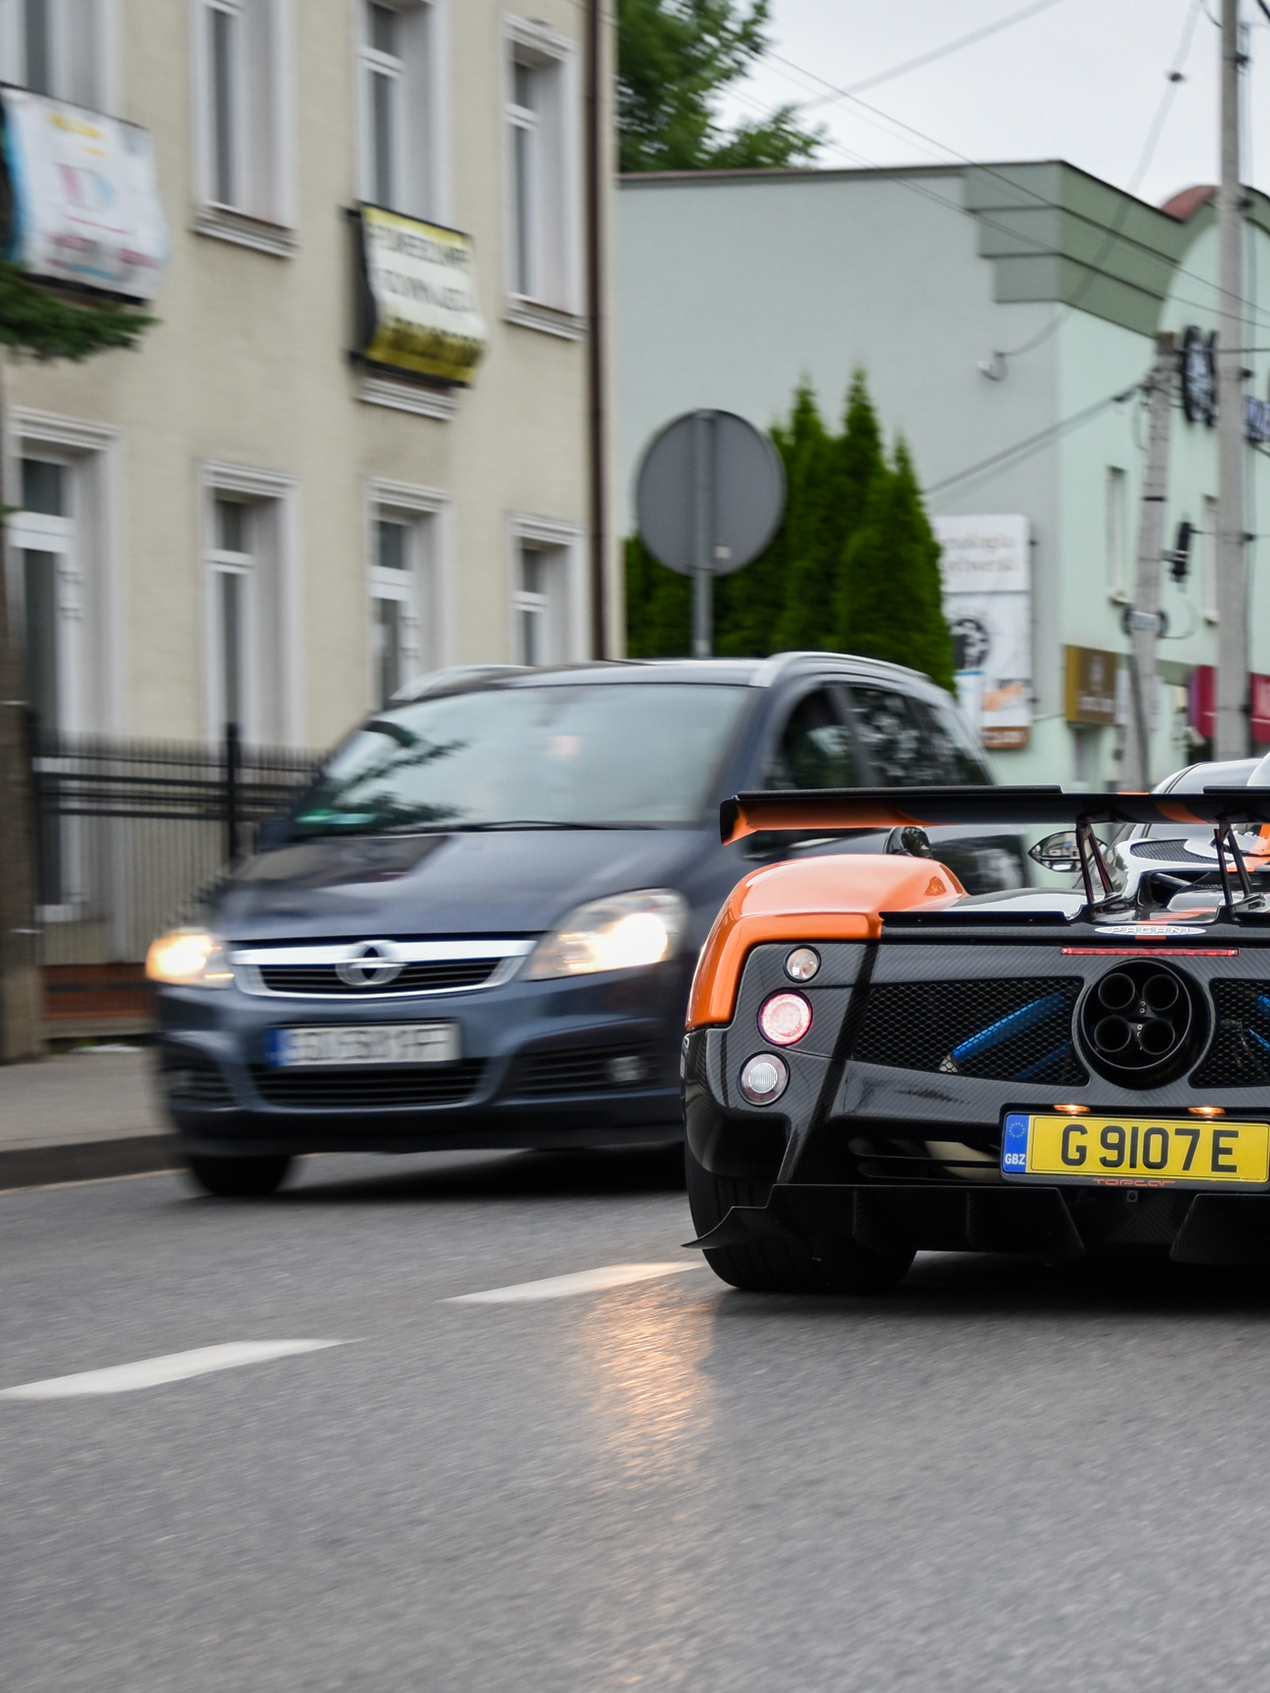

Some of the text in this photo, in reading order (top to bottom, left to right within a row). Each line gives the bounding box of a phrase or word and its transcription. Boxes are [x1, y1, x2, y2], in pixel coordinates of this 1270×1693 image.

[1109, 926, 1190, 935] PAGANI
[1061, 1124, 1088, 1166] G
[1211, 1129, 1239, 1172] E
[1004, 1153, 1025, 1166] GBZ
